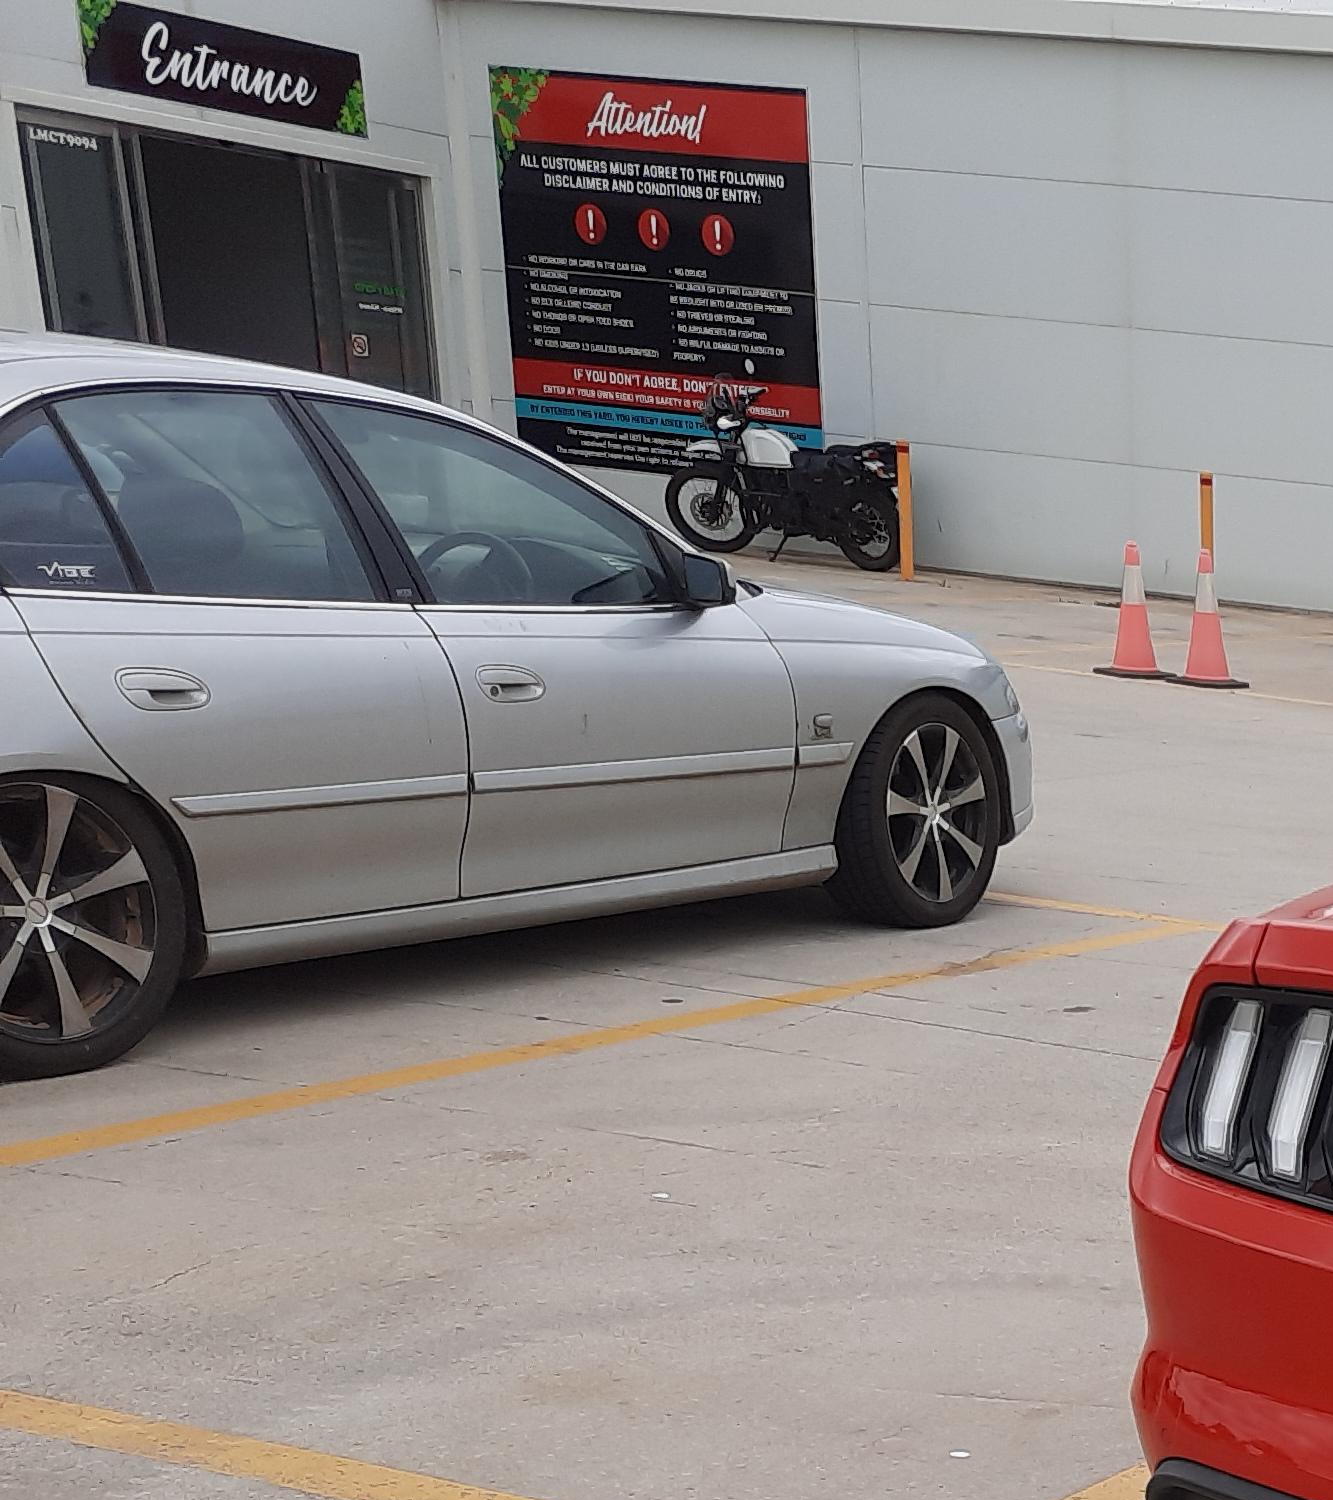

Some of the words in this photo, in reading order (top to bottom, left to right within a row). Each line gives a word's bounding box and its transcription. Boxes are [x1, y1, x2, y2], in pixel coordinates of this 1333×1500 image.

[141, 21, 318, 106] Entrance
[587, 92, 707, 144] Attention!
[520, 154, 538, 169] ALL
[541, 156, 608, 175] CUSTOMERS
[610, 161, 640, 177] MUST
[643, 163, 678, 180] AGREE
[680, 166, 695, 180] TO
[697, 167, 717, 183] THE
[720, 169, 785, 189] FOLLOWING
[544, 173, 610, 192] DISCLAIMER
[612, 178, 635, 194] AND
[636, 181, 703, 200] CONDITIONS
[705, 185, 720, 201] OF
[573, 368, 584, 381] IF
[585, 369, 607, 383] YOU
[609, 372, 640, 387] DON'T
